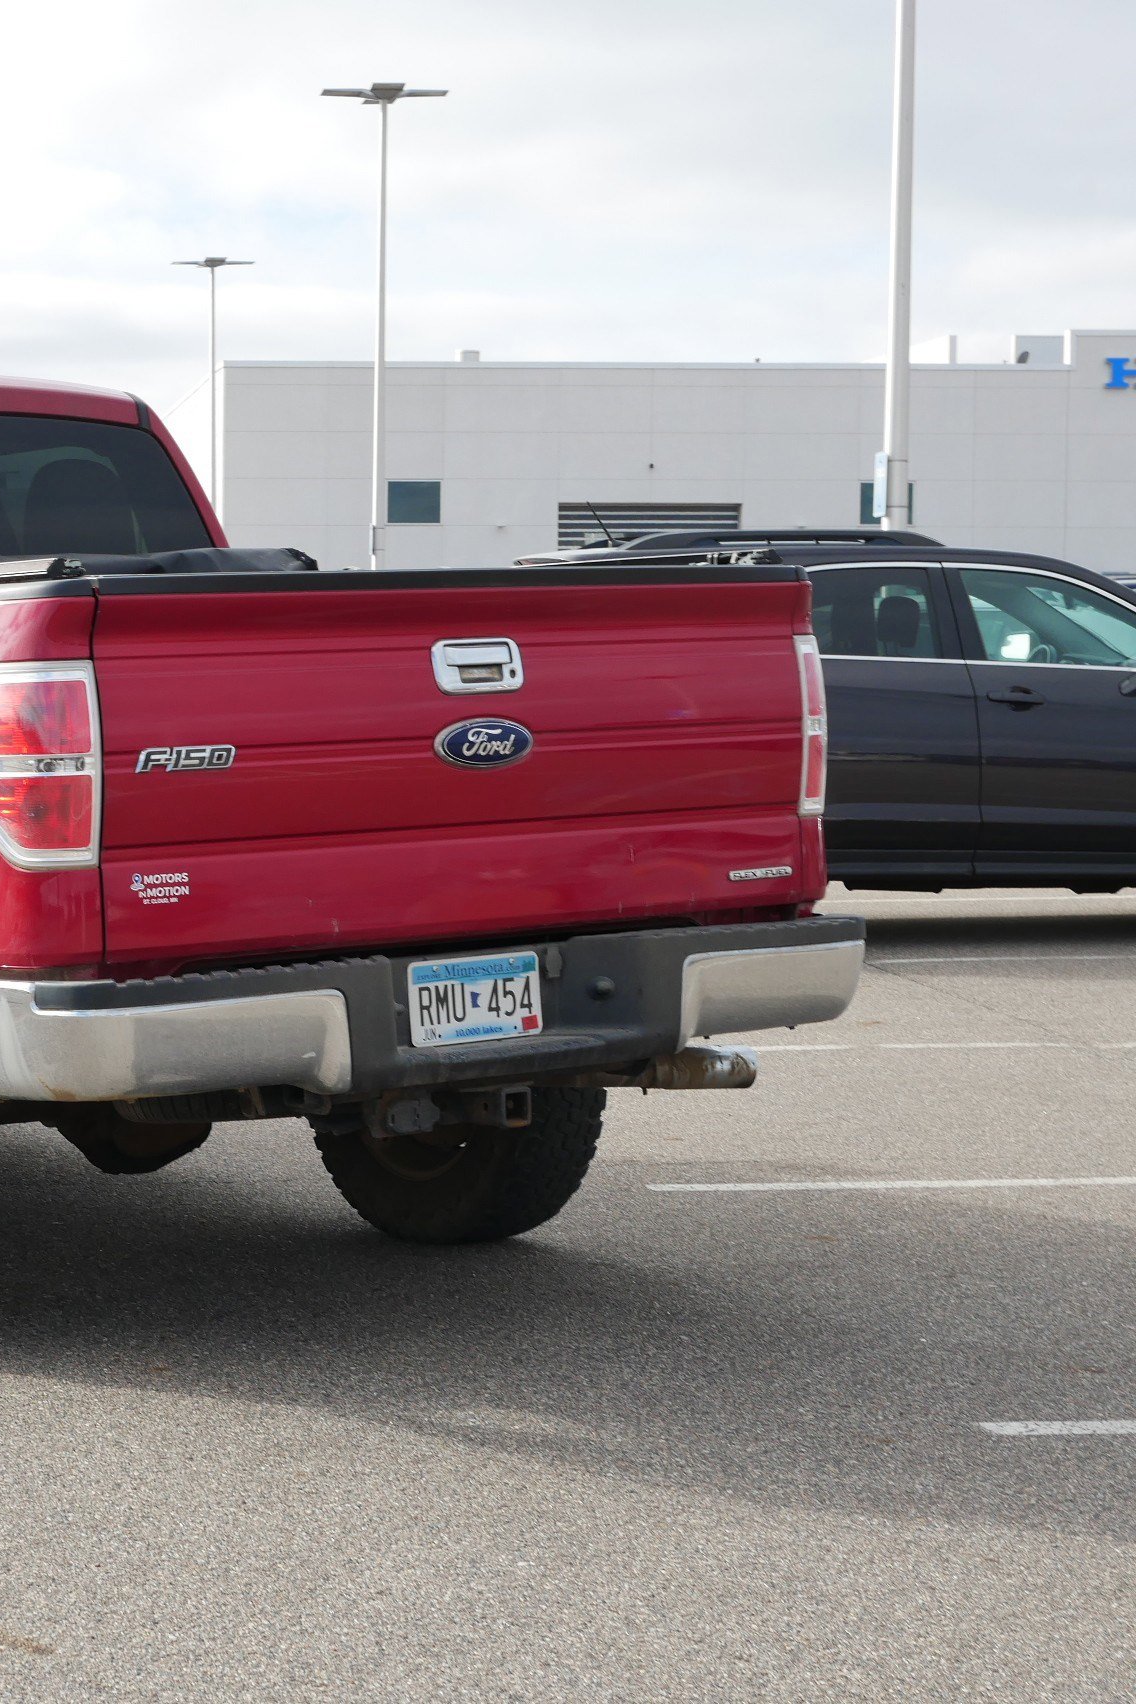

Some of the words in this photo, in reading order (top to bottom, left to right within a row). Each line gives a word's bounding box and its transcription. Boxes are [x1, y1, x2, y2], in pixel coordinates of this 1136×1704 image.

[462, 727, 516, 757] Ford
[135, 744, 236, 773] F-150
[143, 872, 189, 885] MOTORS
[146, 885, 190, 897] MOTION
[418, 982, 467, 1027] RMU
[488, 975, 533, 1018] 454
[455, 1026, 481, 1037] 10,000
[483, 1024, 503, 1034] lakes
